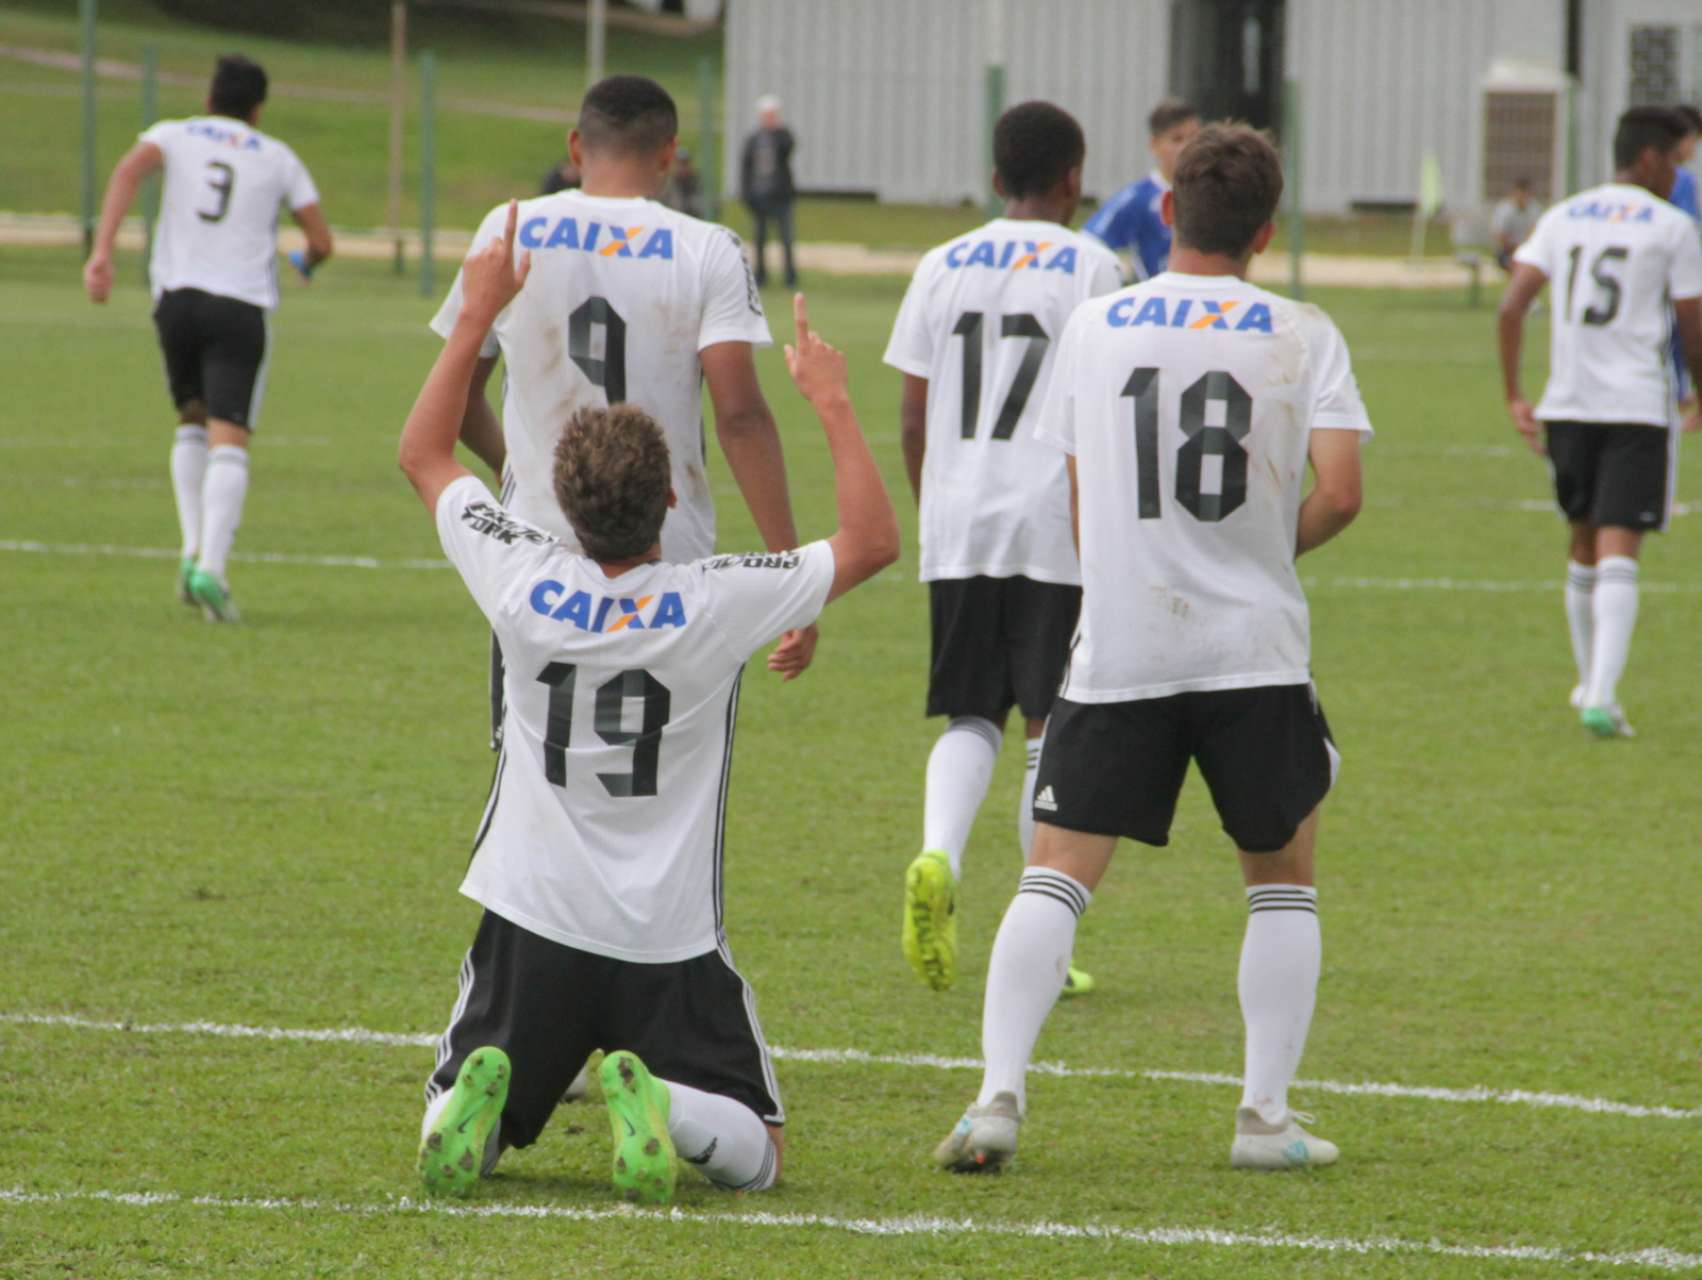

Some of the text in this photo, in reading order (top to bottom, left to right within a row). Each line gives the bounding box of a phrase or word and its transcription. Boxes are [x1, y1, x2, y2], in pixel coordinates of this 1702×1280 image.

[196, 160, 234, 222] 3
[518, 216, 673, 260] CAIXA
[946, 239, 1078, 274] CAIXA
[1107, 296, 1274, 333] CAIXA
[1567, 244, 1628, 326] 15
[569, 296, 626, 405] 9
[953, 311, 1050, 441] 17
[1120, 367, 1253, 522] 18
[529, 579, 687, 634] CAIXA
[536, 661, 671, 797] 19
